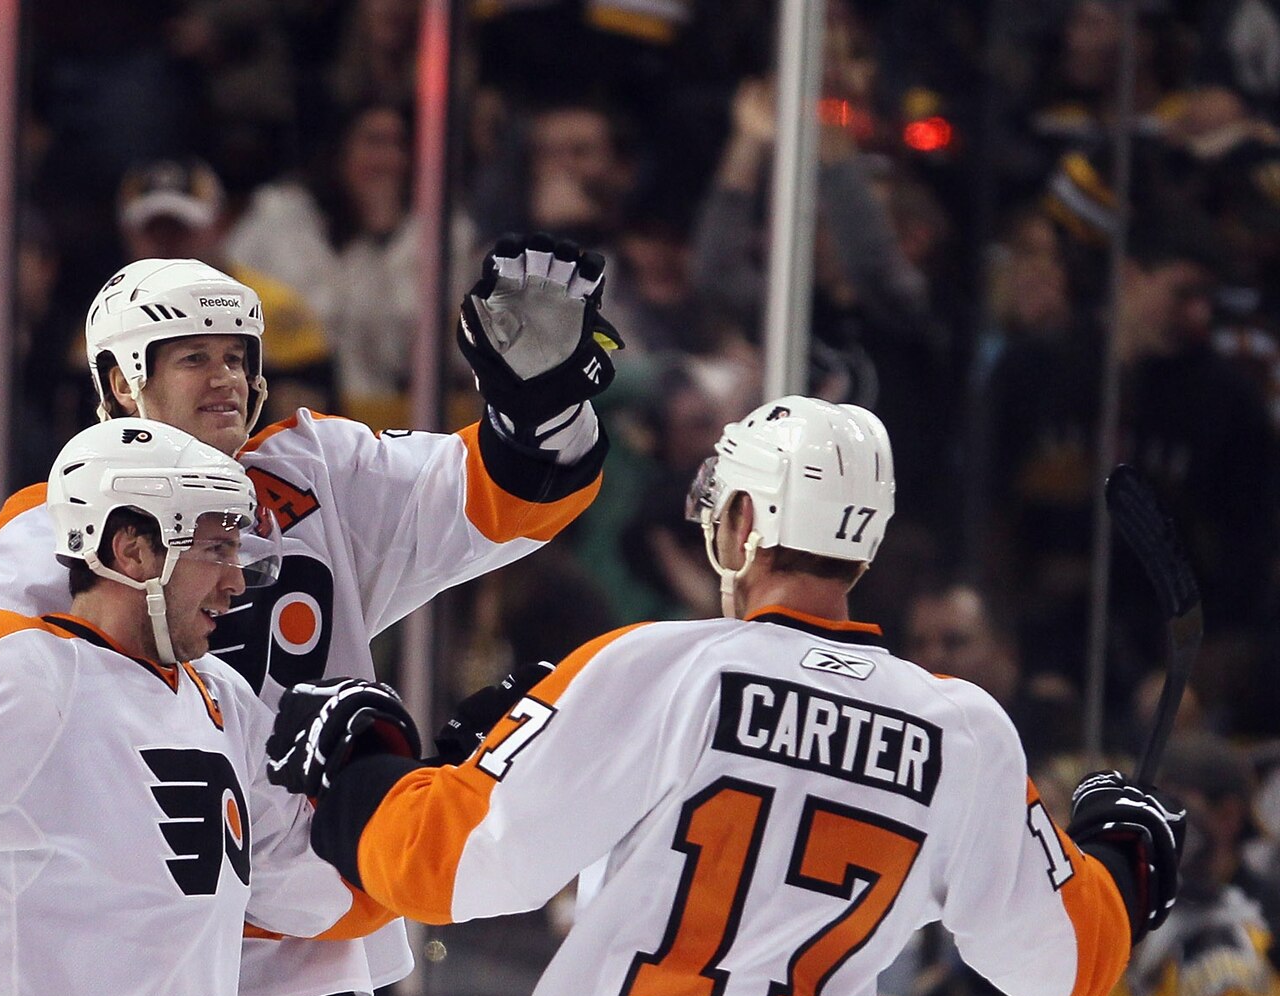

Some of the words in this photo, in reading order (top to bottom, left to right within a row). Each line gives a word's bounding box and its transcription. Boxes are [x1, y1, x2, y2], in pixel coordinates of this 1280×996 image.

[199, 297, 241, 308] Reebok
[246, 465, 320, 536] A
[835, 505, 877, 543] 17
[736, 683, 930, 792] CARTER
